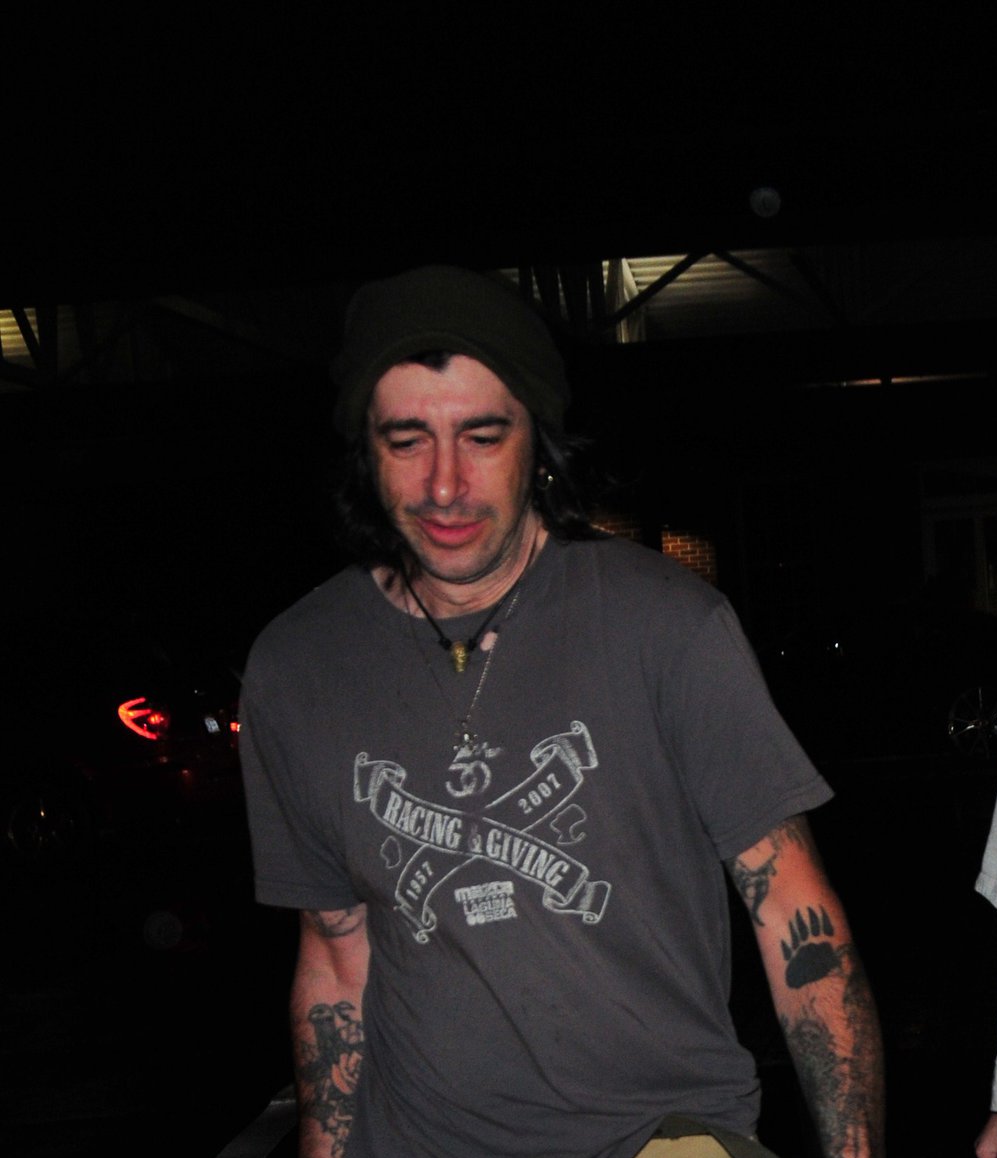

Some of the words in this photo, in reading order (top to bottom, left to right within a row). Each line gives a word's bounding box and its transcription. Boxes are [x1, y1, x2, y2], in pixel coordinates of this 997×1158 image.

[518, 773, 562, 814] 2007
[384, 791, 462, 849] RACING
[486, 828, 570, 886] GIVING
[406, 861, 433, 899] 1957
